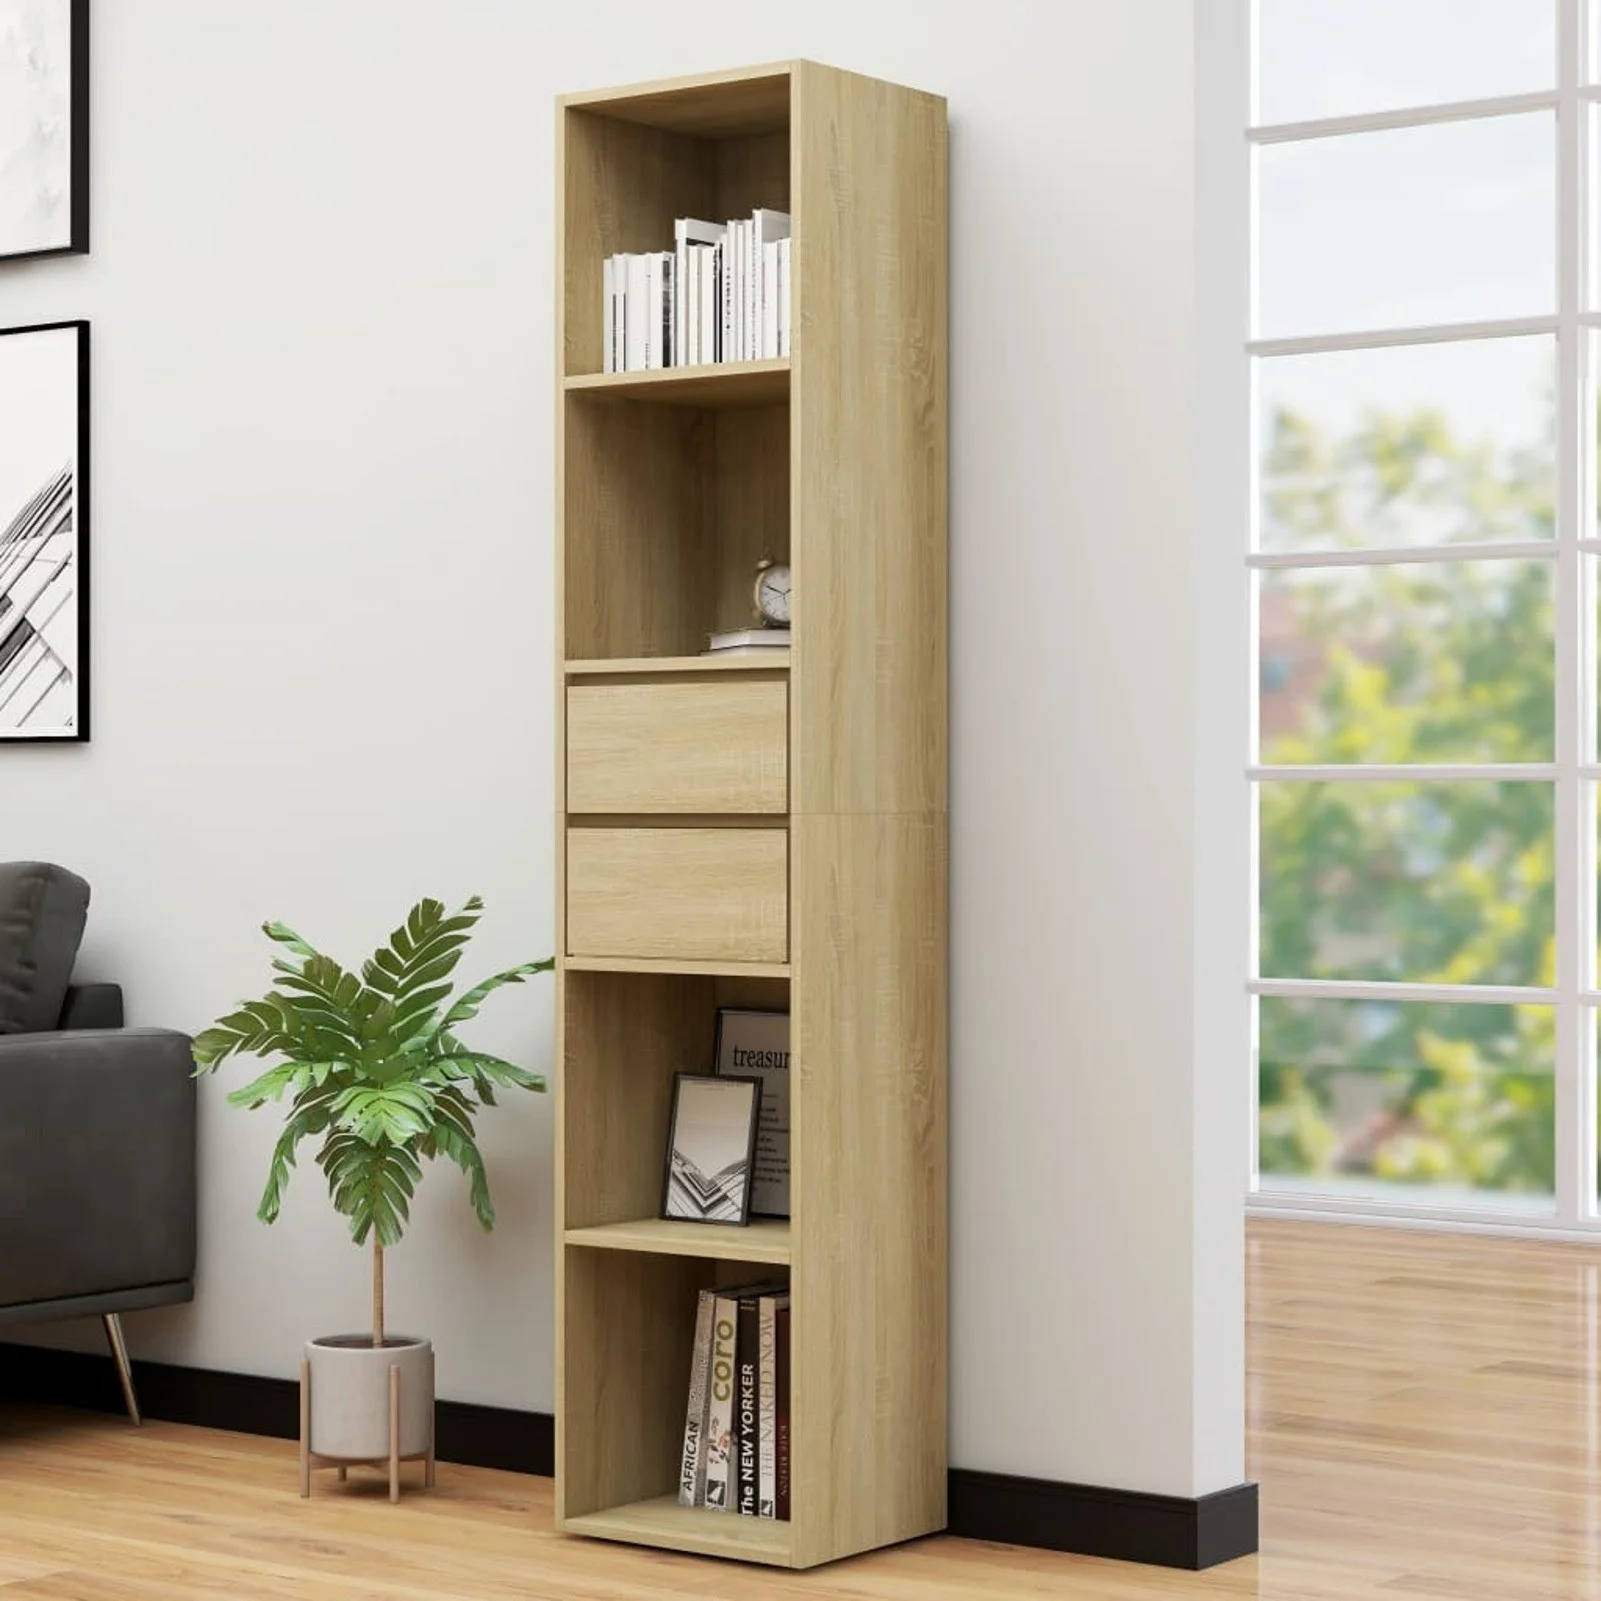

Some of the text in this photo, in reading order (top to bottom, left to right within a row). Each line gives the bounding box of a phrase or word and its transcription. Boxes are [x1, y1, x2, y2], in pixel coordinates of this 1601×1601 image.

[712, 1319, 734, 1401] coro
[760, 1312, 774, 1477] THE NAKED NOW
[682, 1420, 700, 1491] AFRICAN
[741, 1364, 754, 1516] The NEW YORKER
